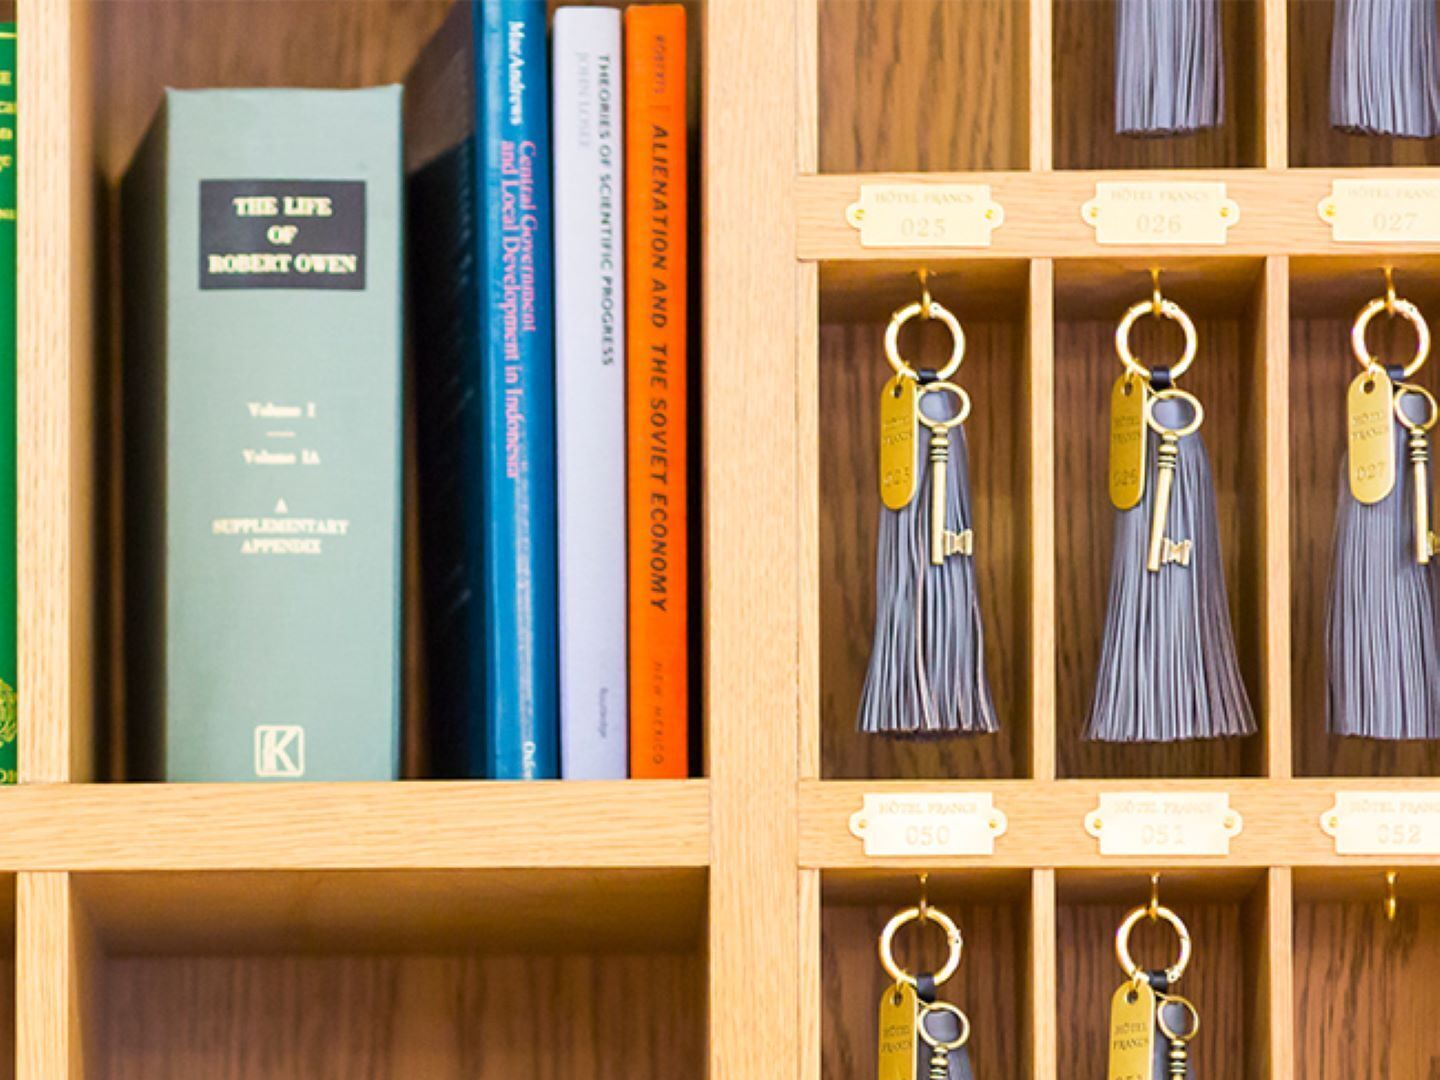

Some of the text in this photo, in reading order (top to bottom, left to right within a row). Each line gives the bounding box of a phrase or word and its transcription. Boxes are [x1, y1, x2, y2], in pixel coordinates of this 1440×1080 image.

[233, 197, 332, 216] THE LIFE
[598, 56, 615, 366] THEORIES OF SCIENTIFIC PROGRESS
[901, 218, 945, 237] 025
[1137, 214, 1182, 234] 026
[1372, 213, 1419, 232] 027
[267, 226, 297, 244] OF
[518, 141, 538, 331] Central Government
[209, 254, 357, 273] ROBERT OWEN
[499, 141, 525, 478] and Local Development in Indonesia
[650, 124, 669, 612] ALIENATION AND THE SOVIET ECONOMY
[274, 498, 288, 513] A
[212, 518, 349, 535] SUPPLEMENTARY
[241, 538, 321, 554] APPENDIX
[906, 825, 950, 846] 050
